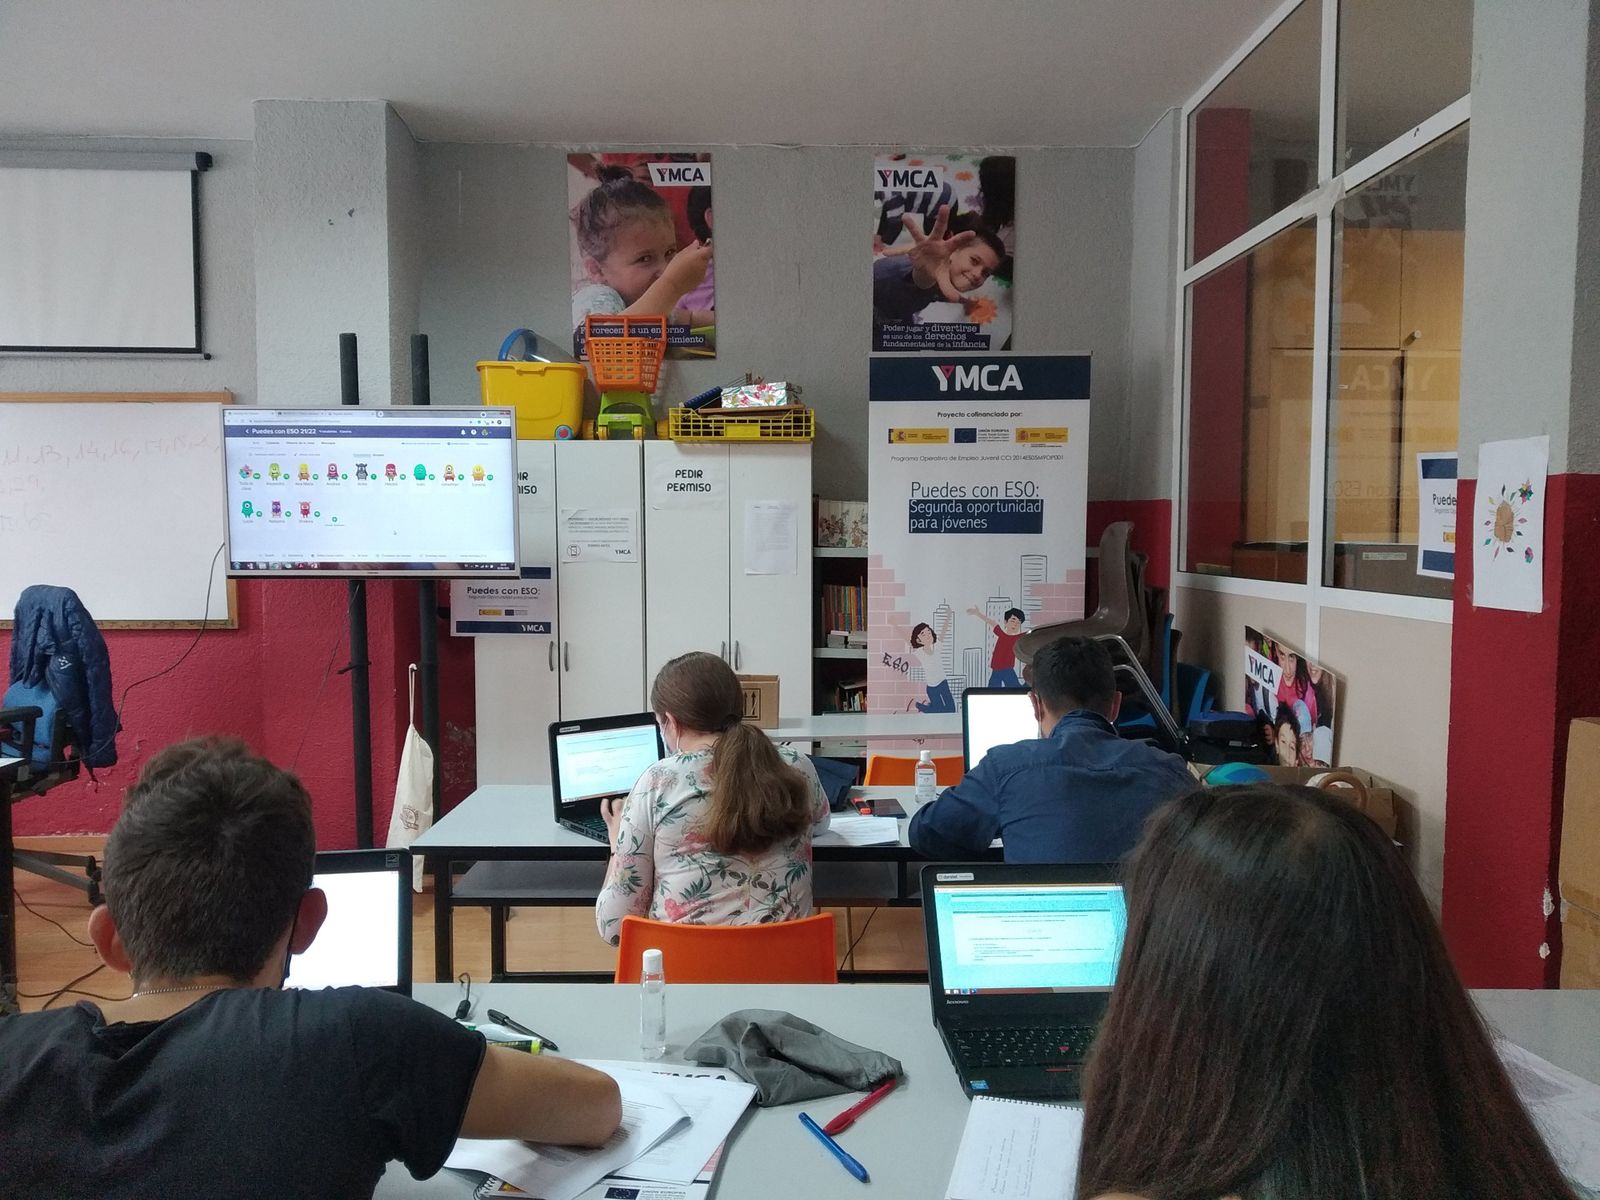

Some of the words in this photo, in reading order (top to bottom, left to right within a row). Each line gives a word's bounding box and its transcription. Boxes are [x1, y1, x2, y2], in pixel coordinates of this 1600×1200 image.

[656, 167, 704, 182] YMCA
[877, 169, 938, 188] YMCA
[931, 324, 977, 332] divertirse
[925, 332, 966, 340] derechos
[952, 340, 988, 348] infancia.
[931, 364, 1024, 391] YMCA
[937, 411, 965, 419] Proyecto
[1010, 411, 1023, 419] por:
[675, 469, 703, 479] PEDIR
[667, 483, 711, 493] PERMISO
[911, 481, 966, 498] Puedes
[972, 485, 998, 498] con
[1005, 480, 1039, 498] ESO:
[910, 499, 963, 517] Segunda
[966, 500, 1042, 516] oportunidad
[910, 517, 938, 532] para
[940, 515, 988, 532] jóvenes
[466, 586, 499, 595] Puedes
[521, 624, 545, 632] YMCA
[1248, 654, 1275, 688] YMCA
